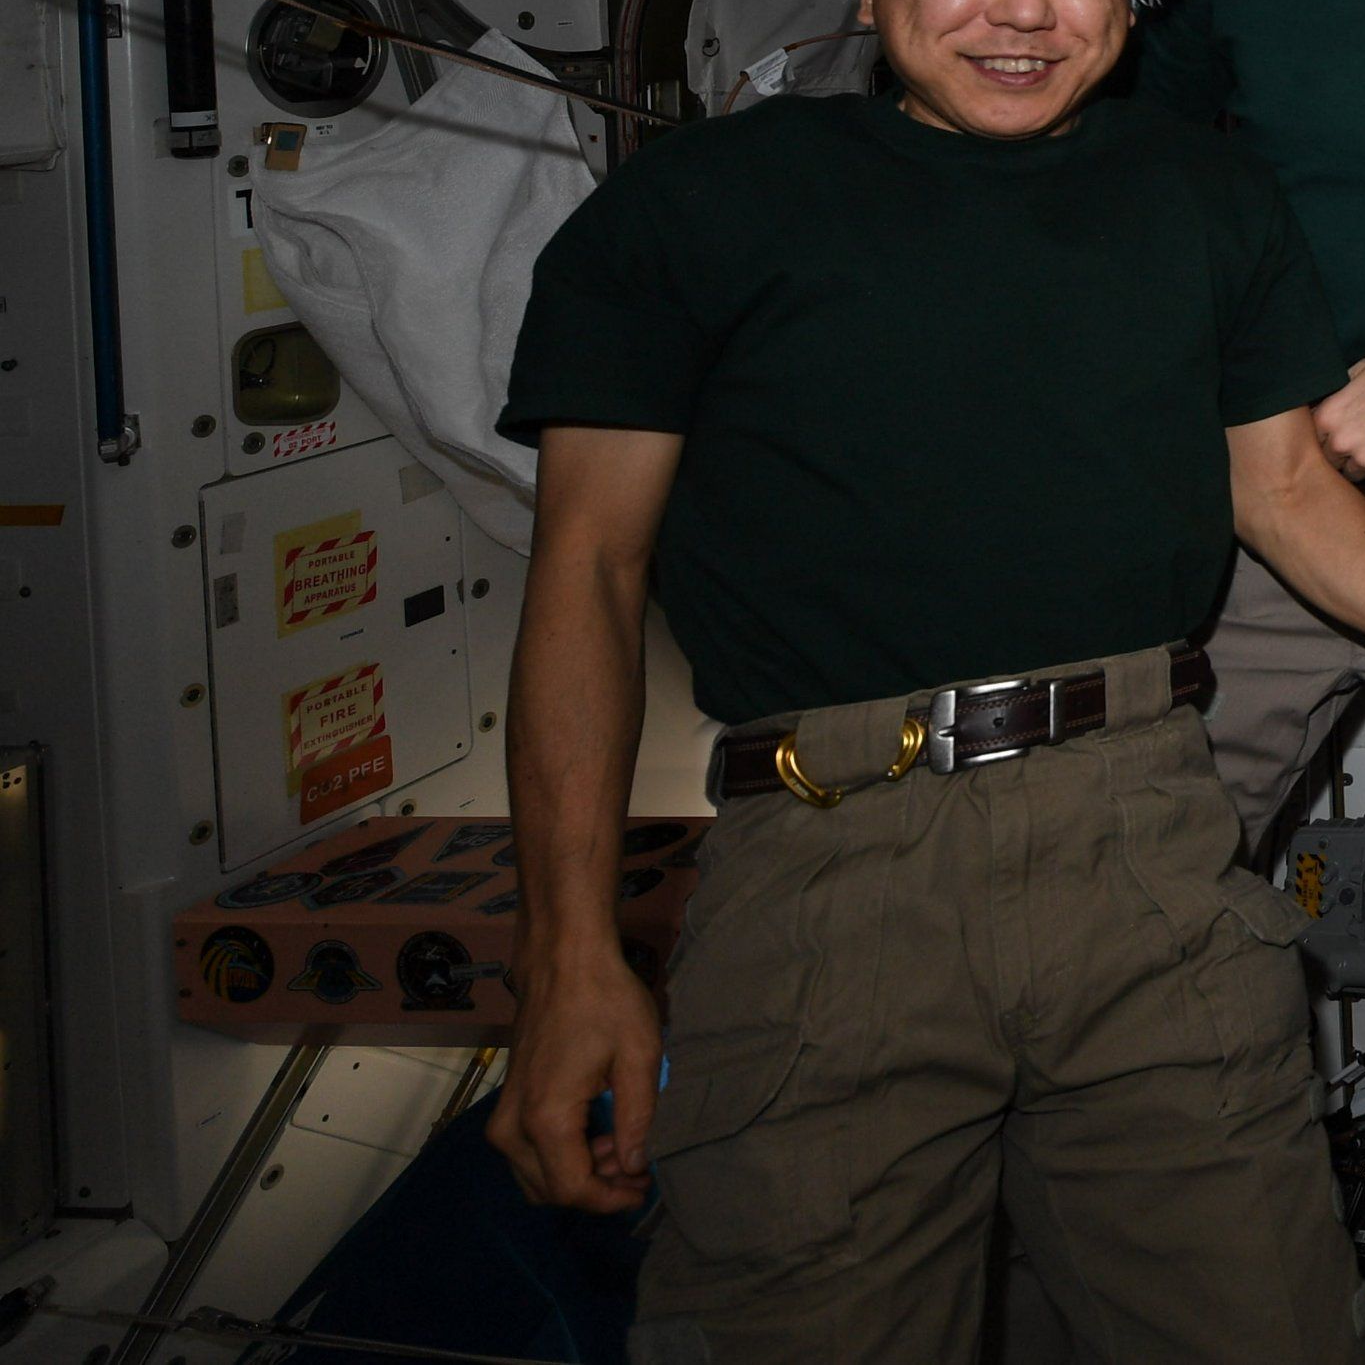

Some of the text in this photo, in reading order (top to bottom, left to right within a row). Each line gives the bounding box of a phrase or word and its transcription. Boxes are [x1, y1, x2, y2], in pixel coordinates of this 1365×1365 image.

[301, 435, 321, 446] PORT
[308, 549, 355, 569] PORTABLE
[294, 563, 367, 592] BREATHING
[304, 582, 357, 605] APPARATUS
[306, 682, 369, 714] PORTABLE
[319, 702, 358, 728] FIRE
[303, 714, 373, 750] EXTINGUISHER
[306, 755, 386, 803] CO2 PFE
